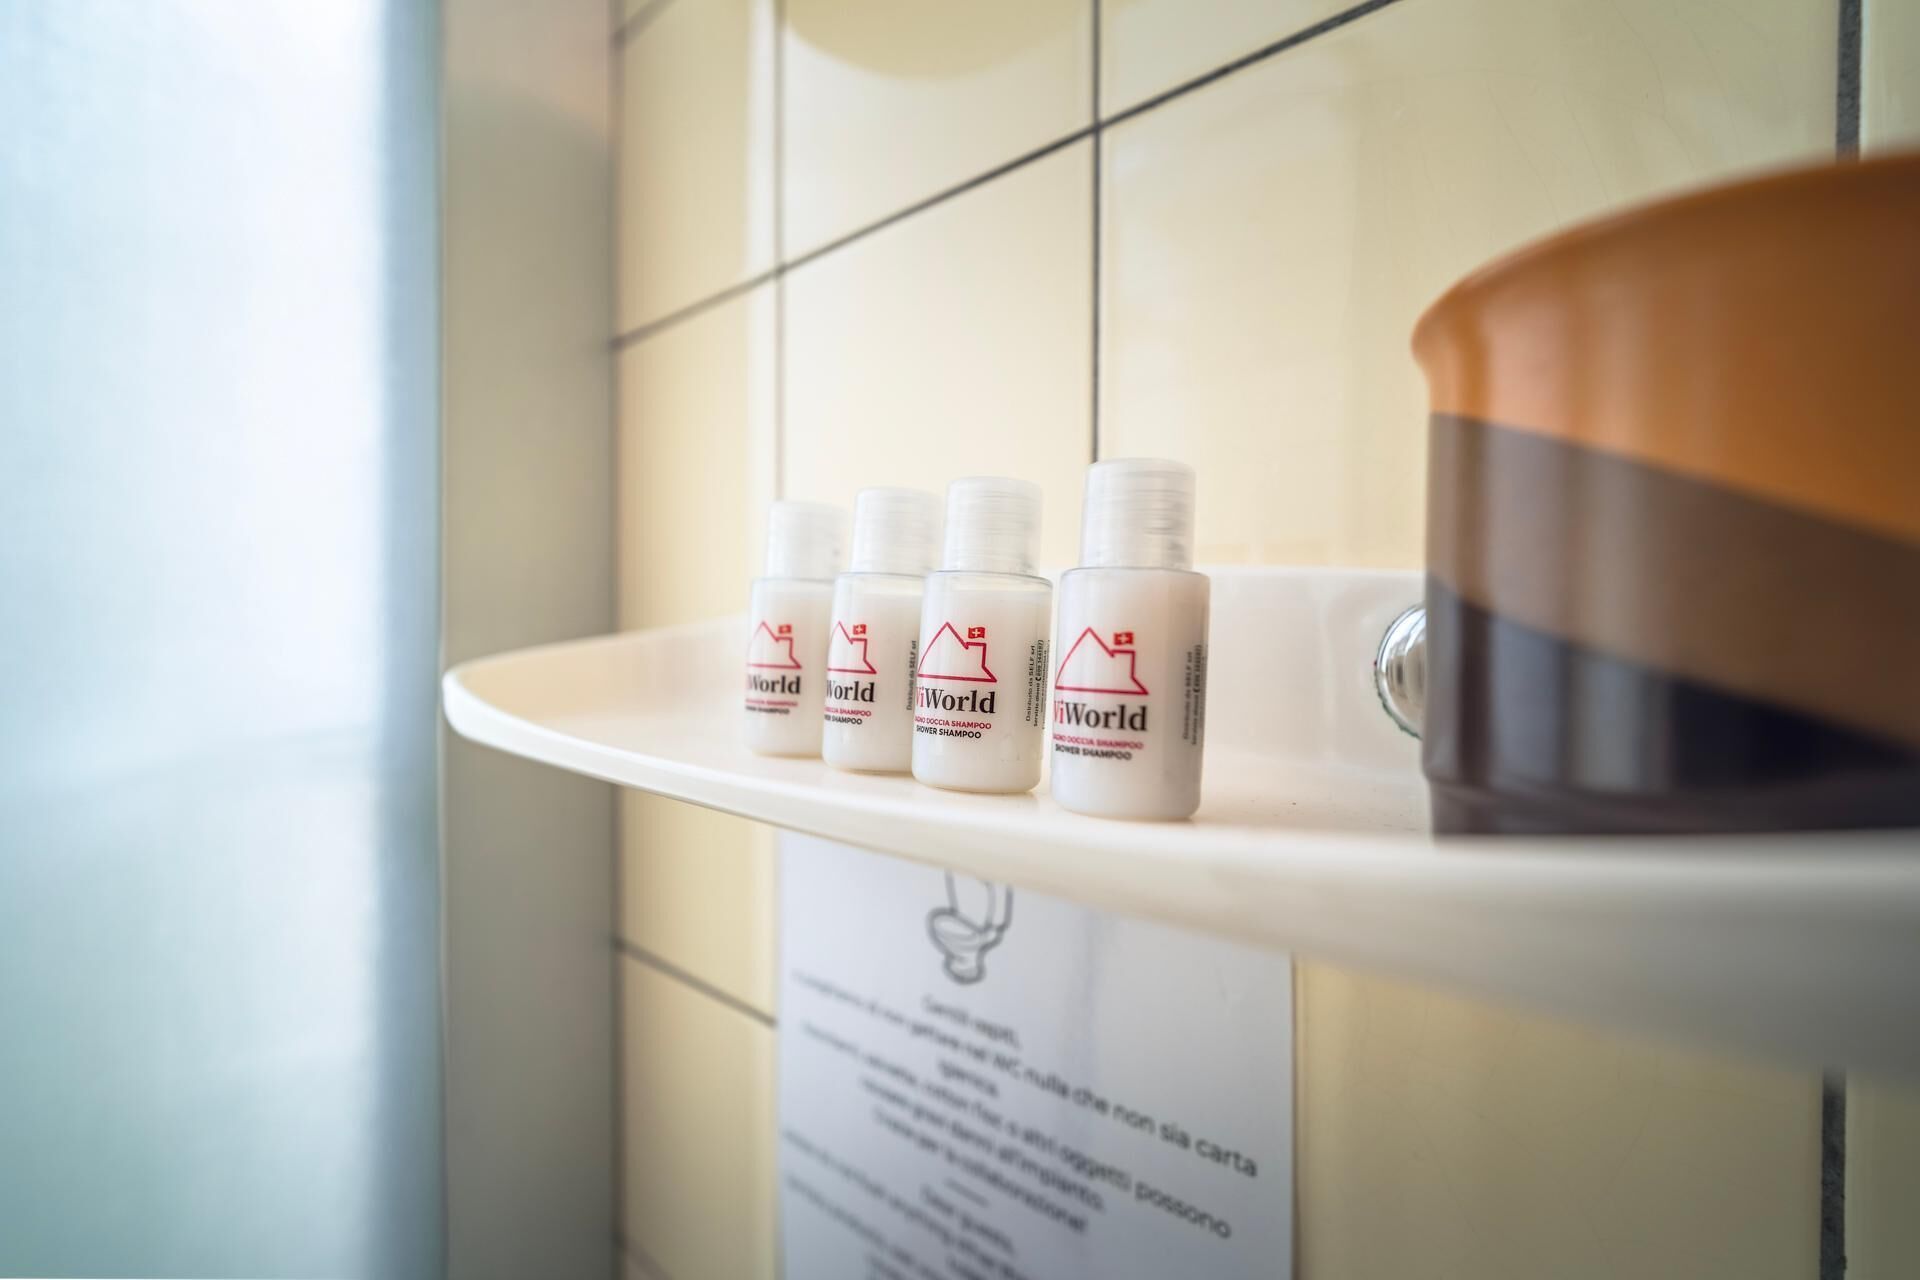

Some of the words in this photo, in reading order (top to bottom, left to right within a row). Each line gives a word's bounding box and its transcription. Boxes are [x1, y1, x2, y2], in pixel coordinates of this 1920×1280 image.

[938, 727, 982, 739] SHAMPOO
[951, 720, 992, 730] SHAMPOO
[1023, 1066, 1070, 1099] nulla
[1071, 1085, 1110, 1116] che
[1112, 1102, 1156, 1136] non
[1158, 1119, 1192, 1150] sia
[1195, 1137, 1258, 1178] carta
[1135, 1180, 1232, 1240] possono
